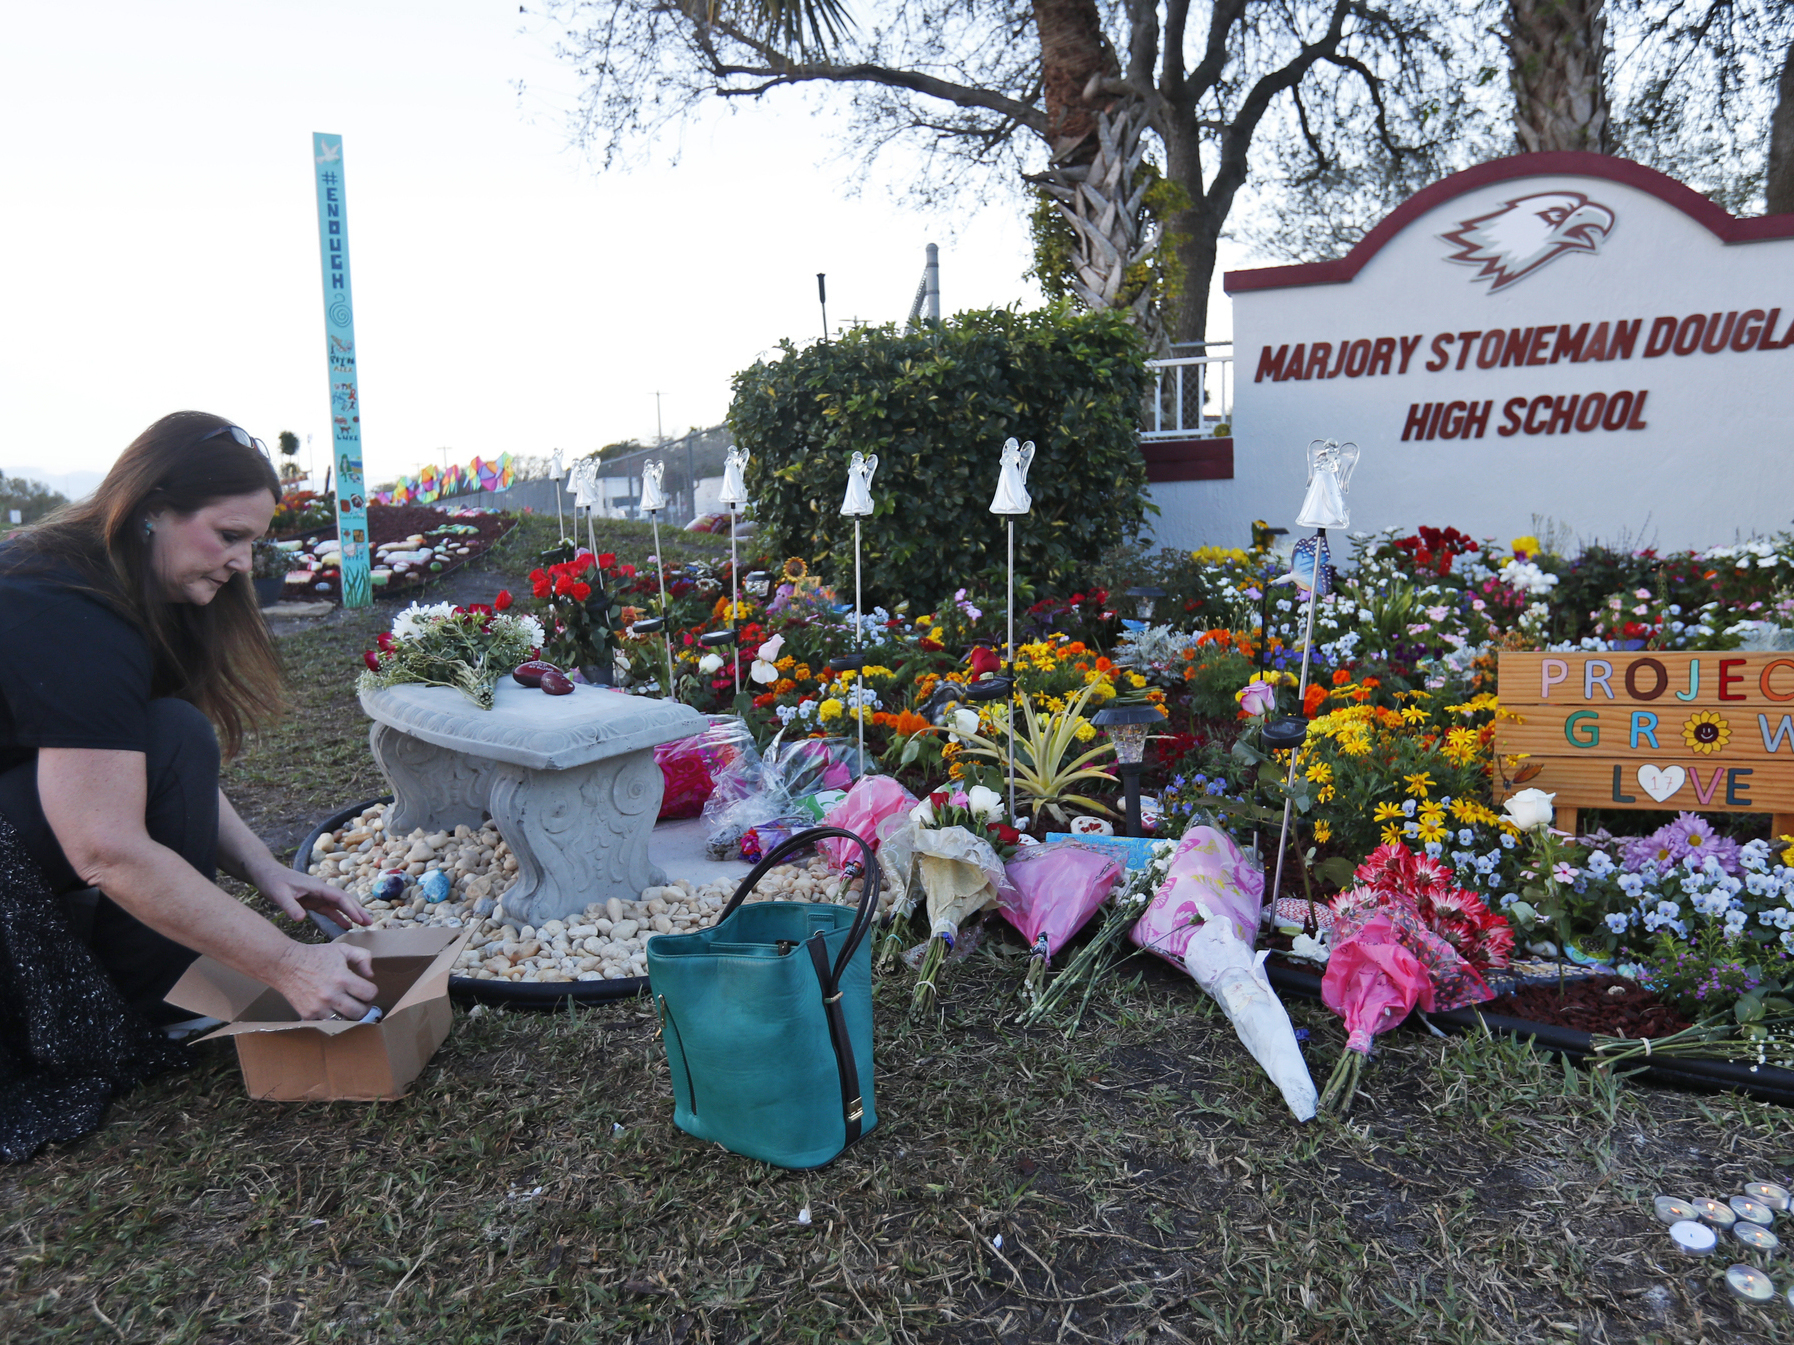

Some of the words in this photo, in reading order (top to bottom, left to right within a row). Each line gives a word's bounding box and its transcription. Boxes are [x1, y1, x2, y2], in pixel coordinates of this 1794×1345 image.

[321, 171, 345, 289] #ENOUGH
[1254, 335, 1422, 383] MARJORY
[1425, 319, 1642, 372] STONEMAN
[1401, 400, 1493, 441] HIGH
[1496, 389, 1650, 437] SCHOOL
[1540, 657, 1794, 702] PROJEC
[1649, 775, 1674, 791] 17
